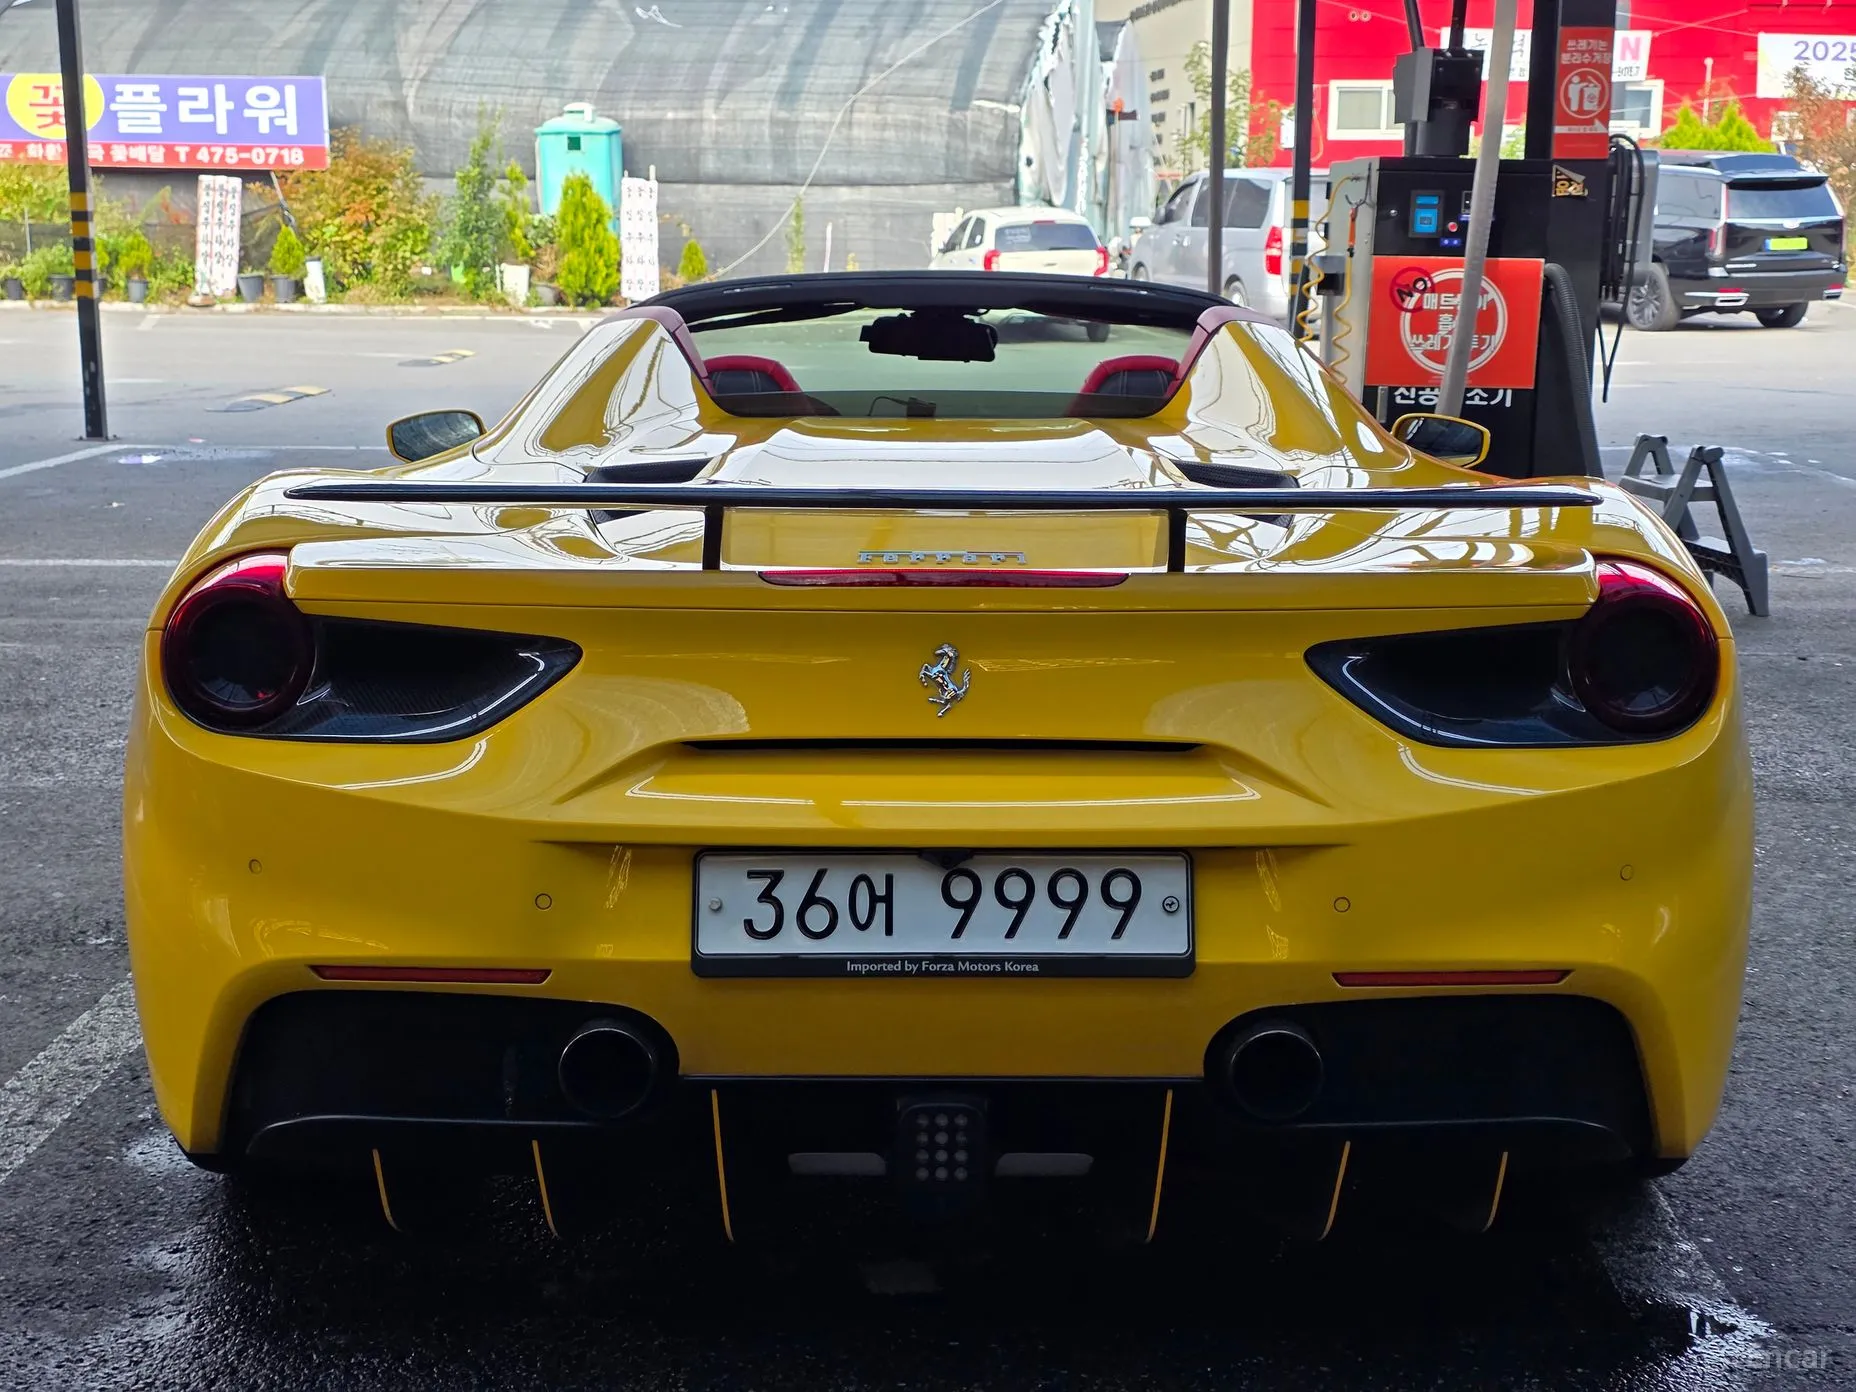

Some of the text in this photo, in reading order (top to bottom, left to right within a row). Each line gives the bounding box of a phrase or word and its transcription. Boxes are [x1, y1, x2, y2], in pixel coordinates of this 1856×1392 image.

[109, 83, 298, 136] 플라워
[174, 147, 190, 163] T
[196, 147, 304, 166] 475-0718
[743, 867, 1143, 941] 36어 9999
[847, 960, 1039, 974] Imported by Forza Motors Korea
